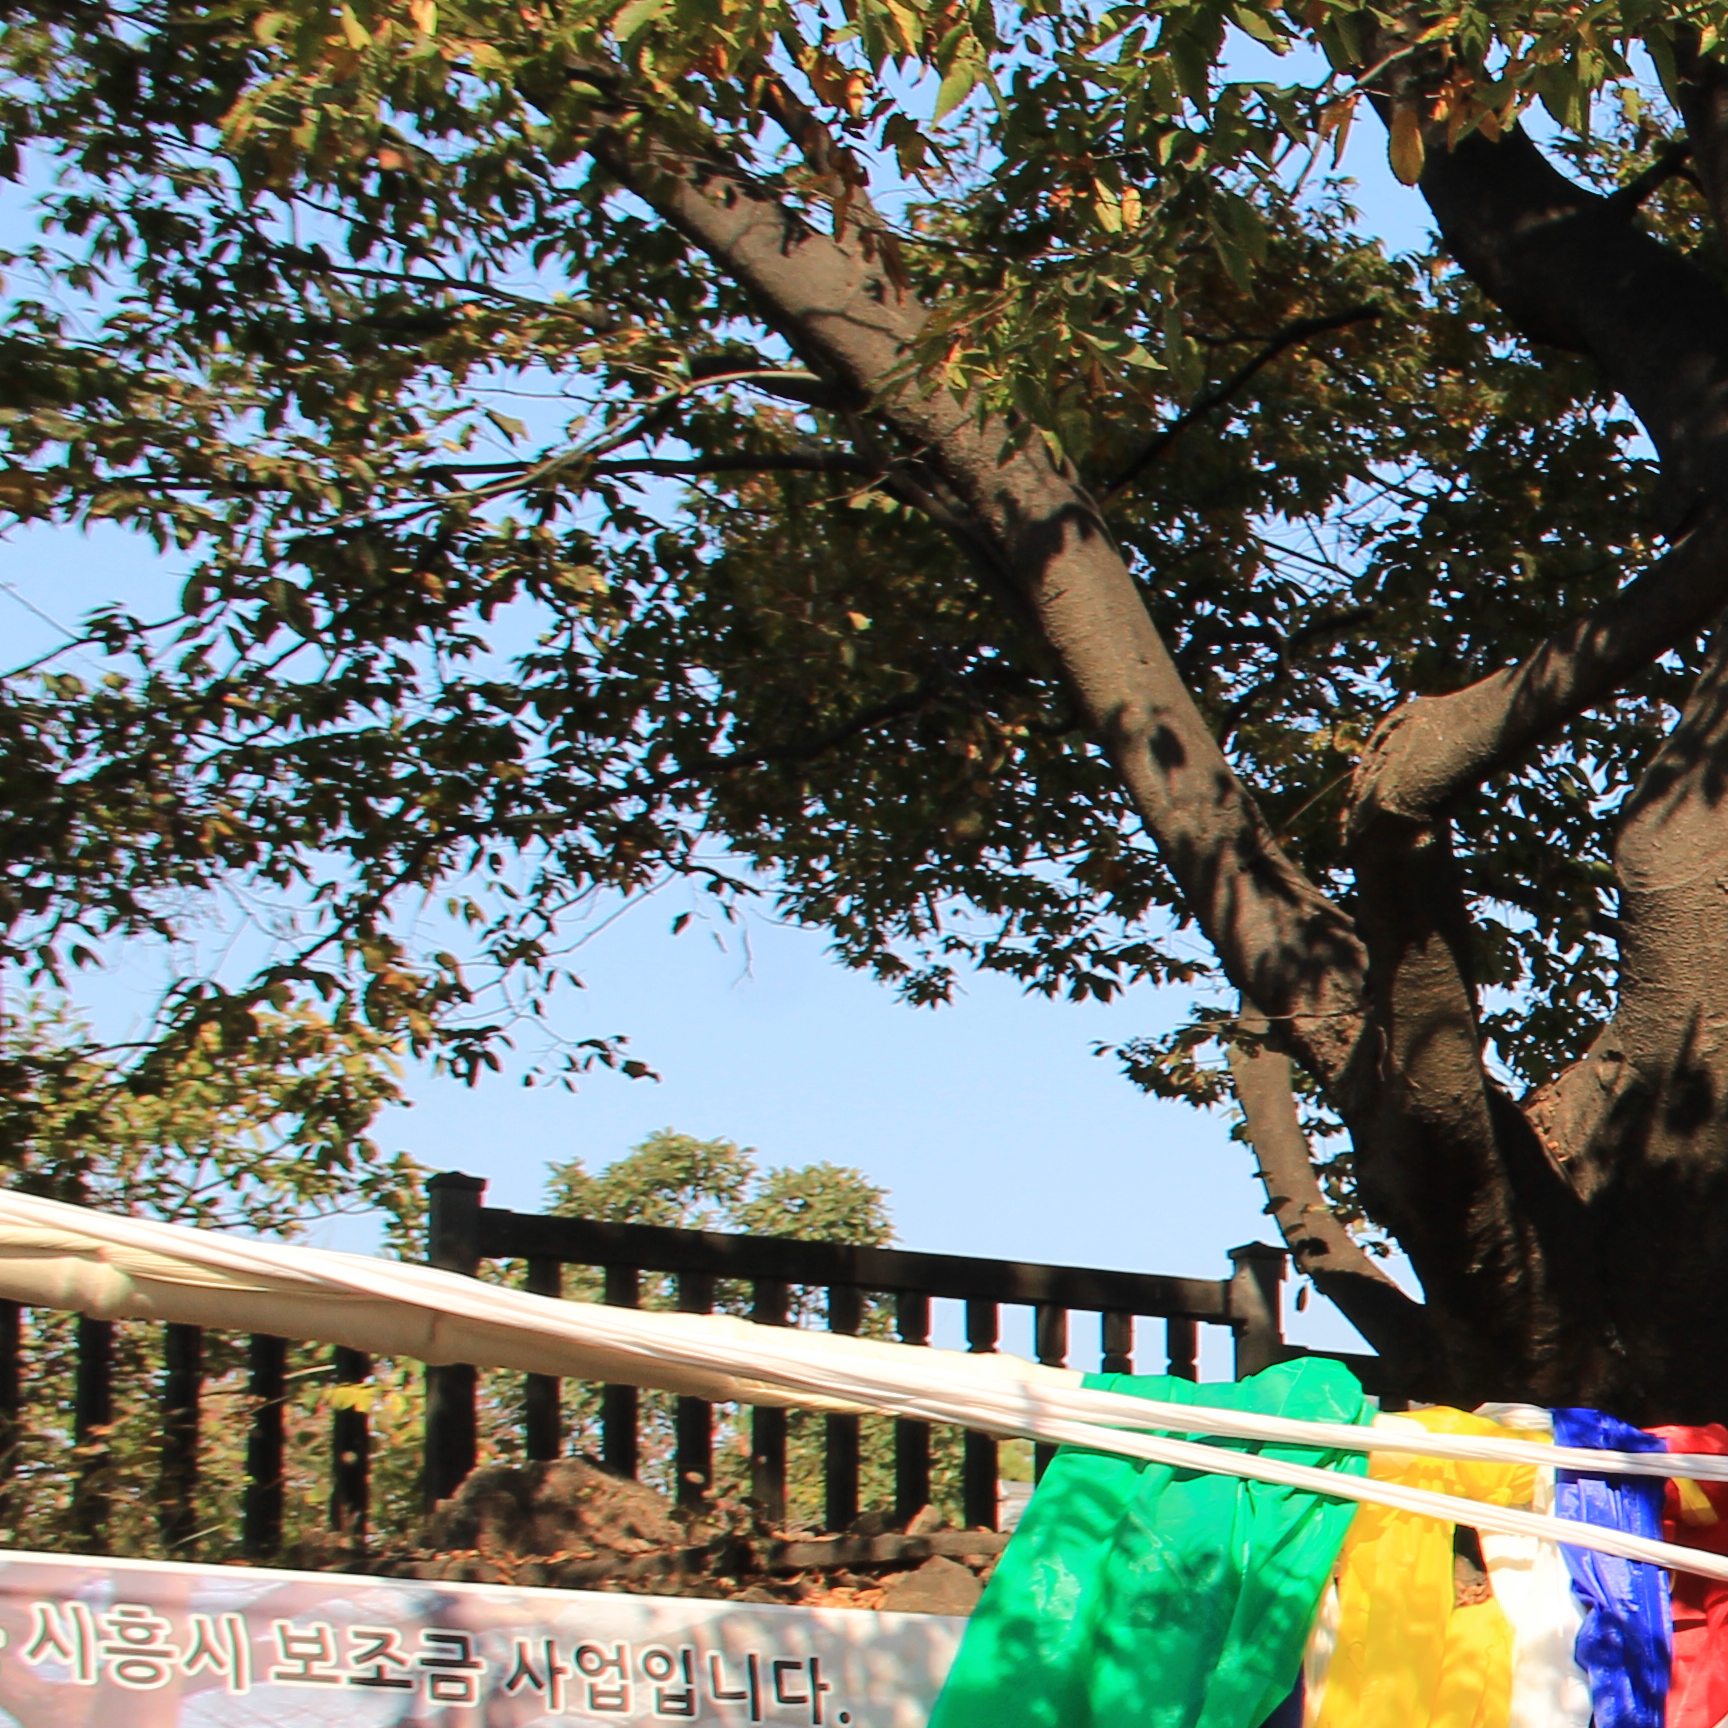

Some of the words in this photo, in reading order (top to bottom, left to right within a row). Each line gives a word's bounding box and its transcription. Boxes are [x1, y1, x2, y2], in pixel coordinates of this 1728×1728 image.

[26, 1600, 250, 1692] 시흥시
[272, 1617, 483, 1704] 보조금
[502, 1637, 852, 1726] 사업입니다.
